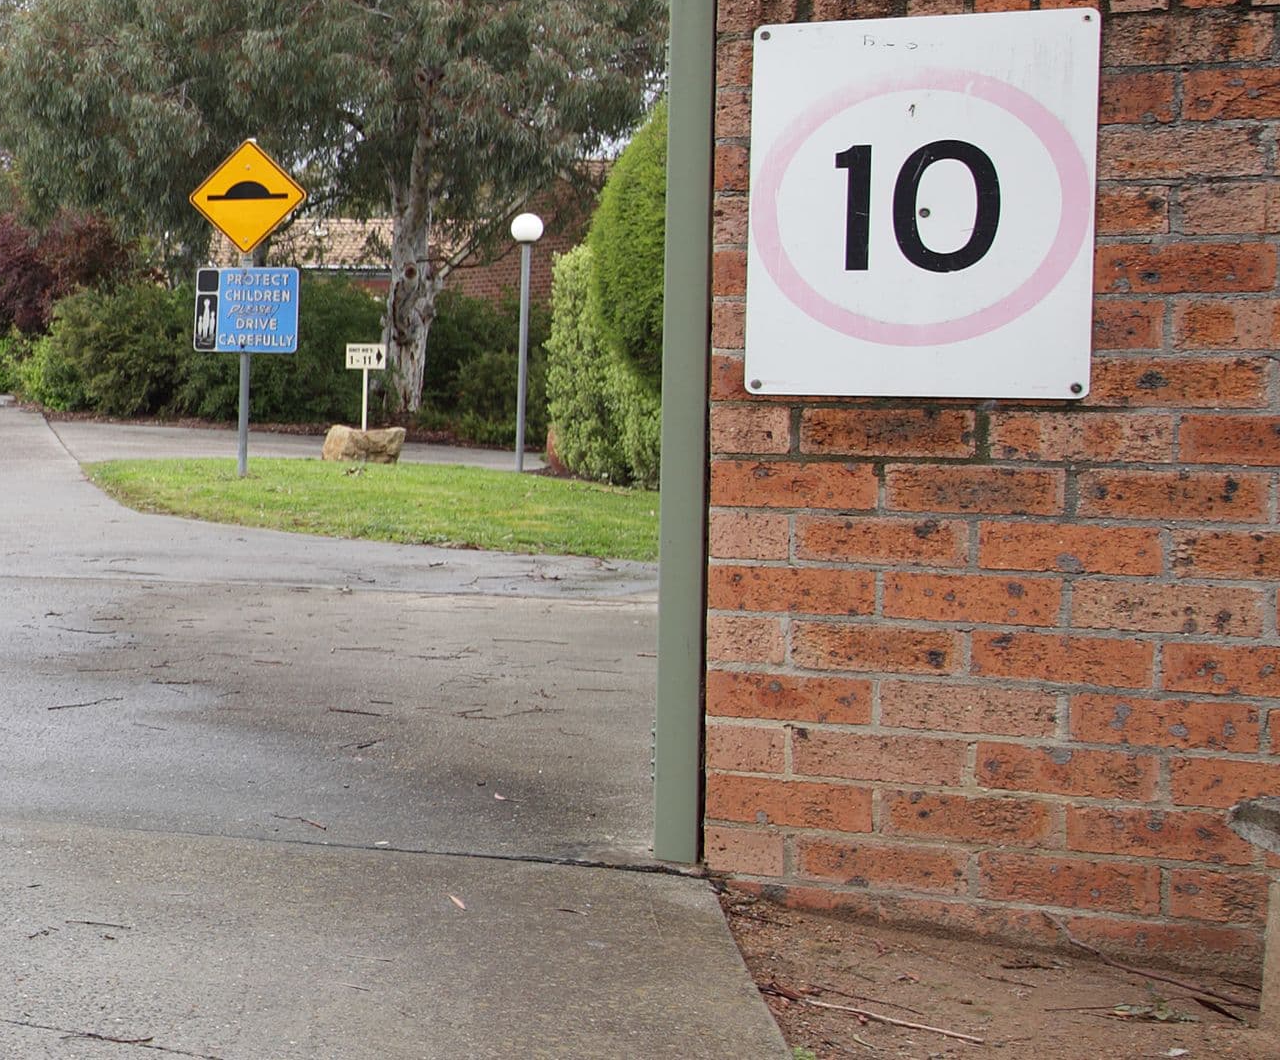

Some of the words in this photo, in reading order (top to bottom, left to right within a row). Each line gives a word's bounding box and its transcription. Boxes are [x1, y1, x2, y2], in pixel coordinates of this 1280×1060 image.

[835, 139, 1000, 273] 10
[227, 273, 290, 286] PROTECT
[225, 290, 291, 302] CHILDREN
[236, 318, 278, 331] DRIVE
[218, 333, 295, 347] CAREFULLY
